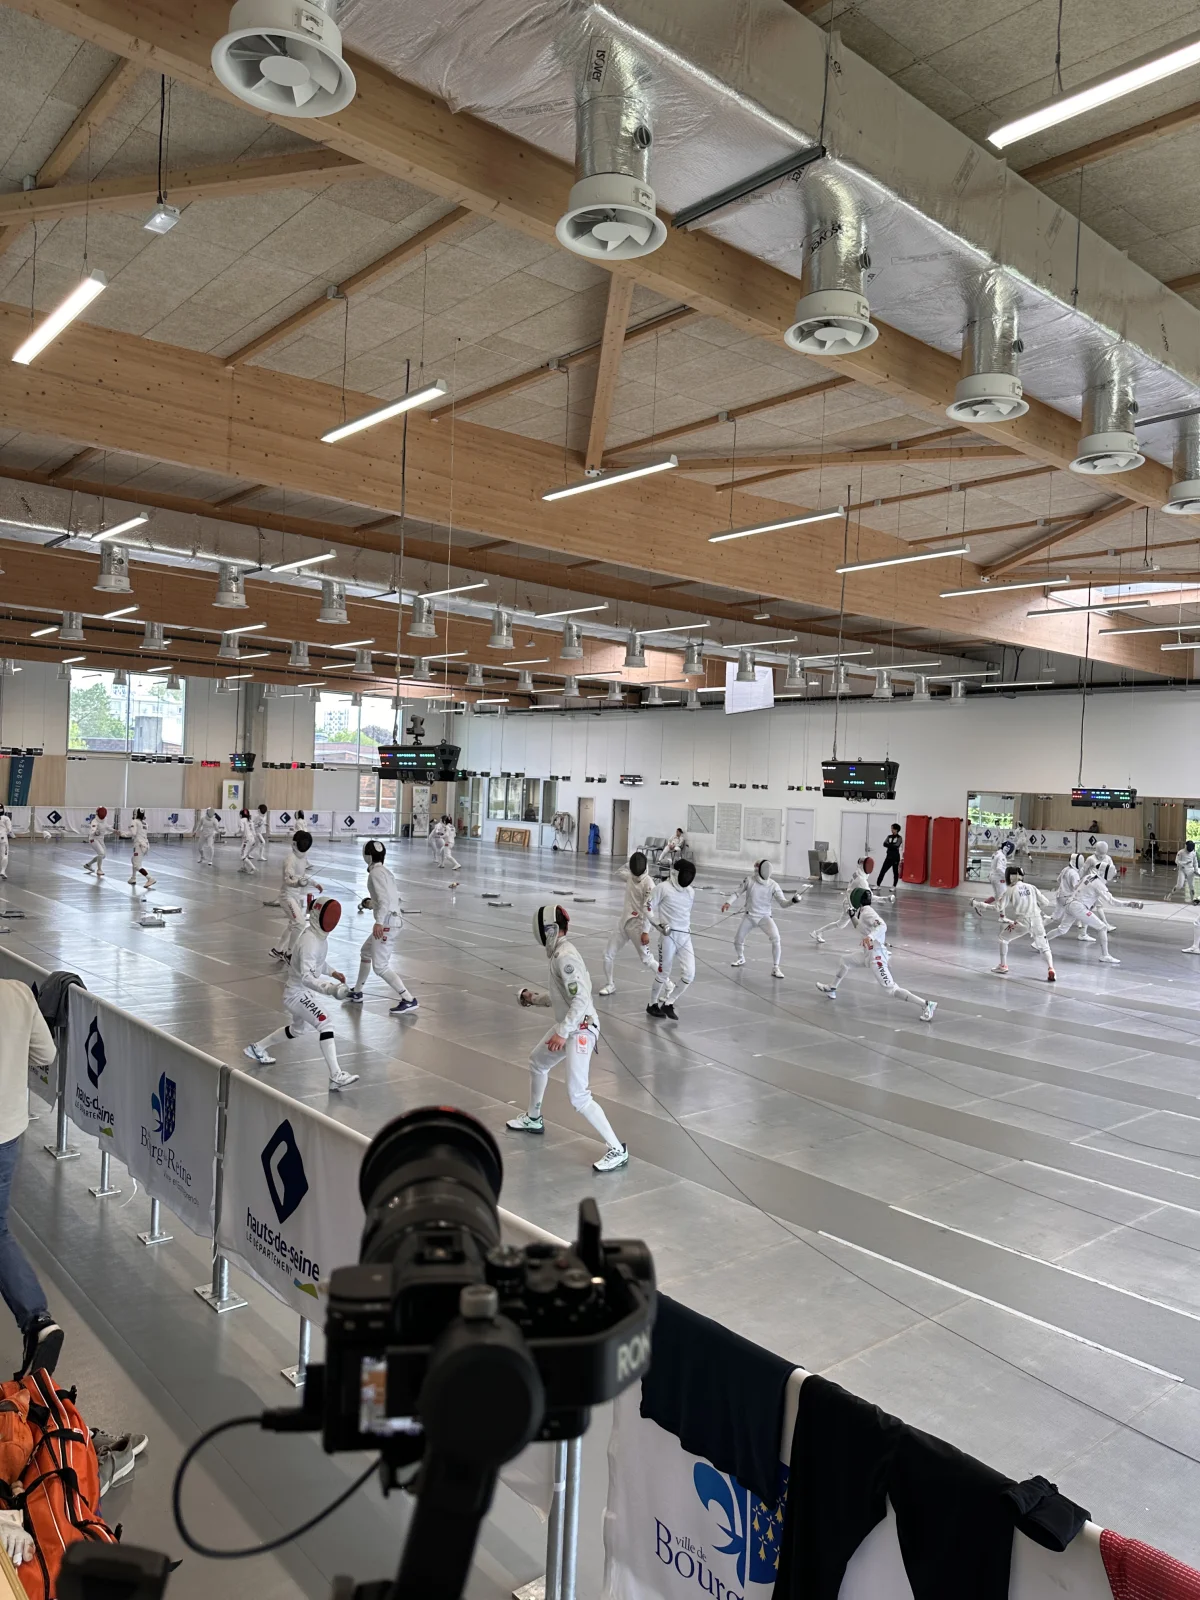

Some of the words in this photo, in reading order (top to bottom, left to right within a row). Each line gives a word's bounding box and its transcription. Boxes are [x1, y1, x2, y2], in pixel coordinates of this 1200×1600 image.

[16, 758, 26, 779] 2024
[426, 771, 436, 781] 02
[13, 779, 22, 802] PARIS
[876, 792, 886, 800] 06
[877, 965, 891, 986] JAPAN
[299, 994, 323, 1019] JAPAN
[167, 1147, 192, 1187] Reine
[246, 1206, 320, 1282] hauts-de-seine
[246, 1230, 253, 1243] LE
[253, 1237, 293, 1277] DÉPARTEMENT
[675, 1535, 696, 1554] ville
[696, 1545, 707, 1563] de
